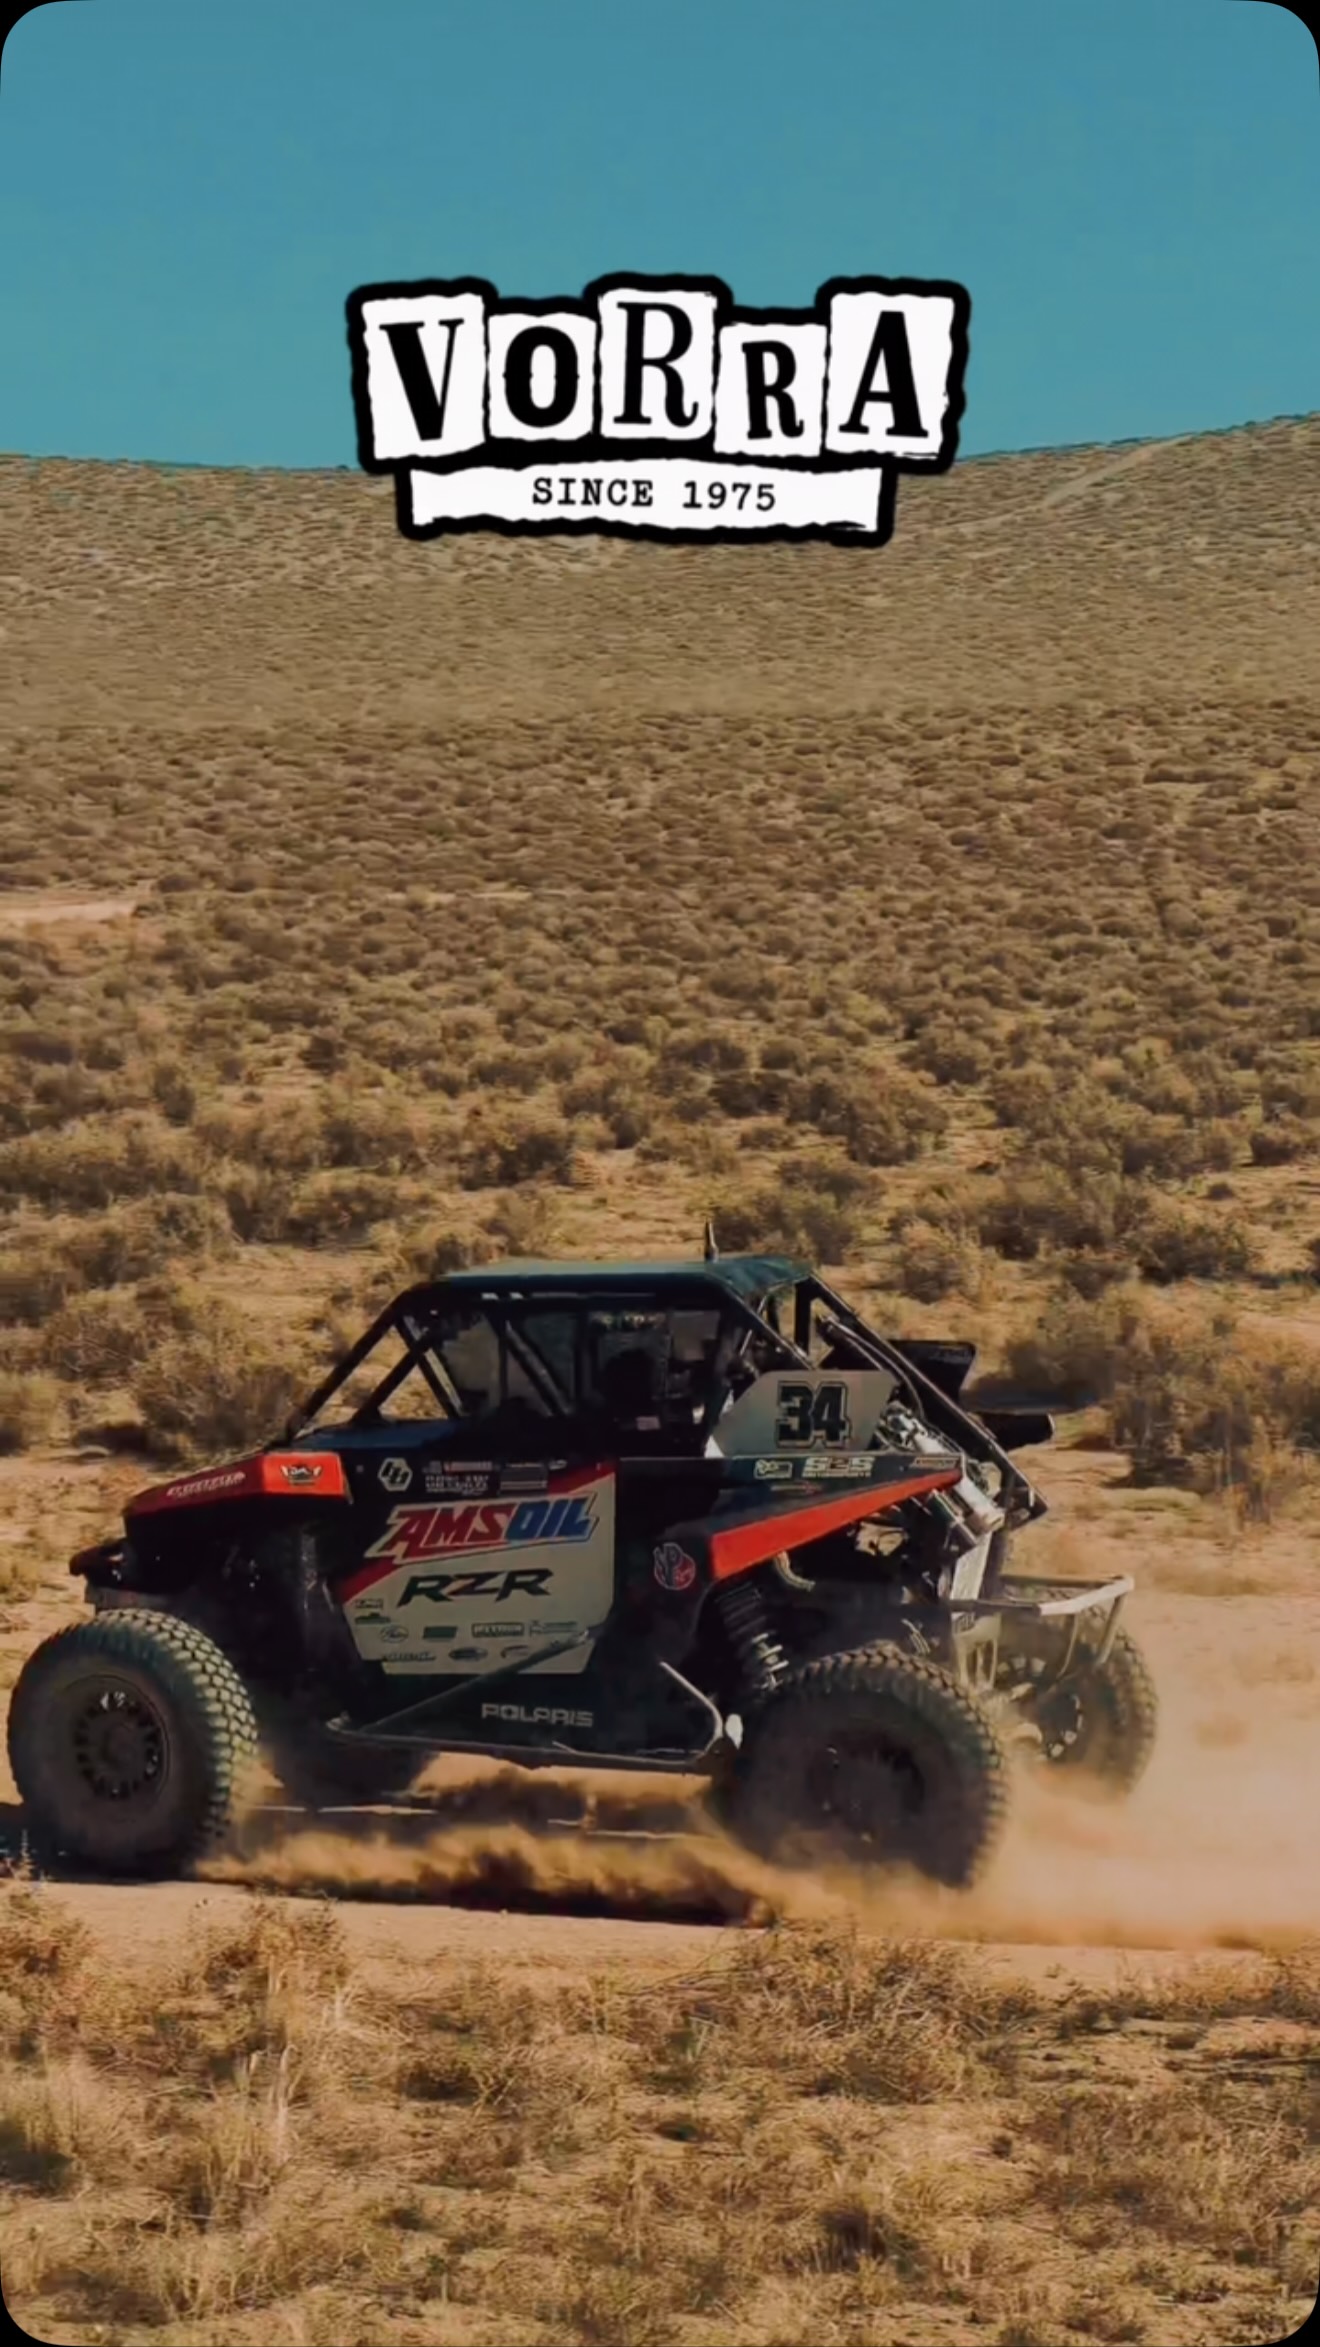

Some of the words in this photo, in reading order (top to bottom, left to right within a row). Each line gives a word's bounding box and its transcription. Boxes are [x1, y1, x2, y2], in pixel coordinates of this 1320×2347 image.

[775, 1379, 851, 1449] 34
[364, 1492, 598, 1565] AMSOIL
[396, 1568, 554, 1607] RZR
[481, 1702, 594, 1727] POLARIS
